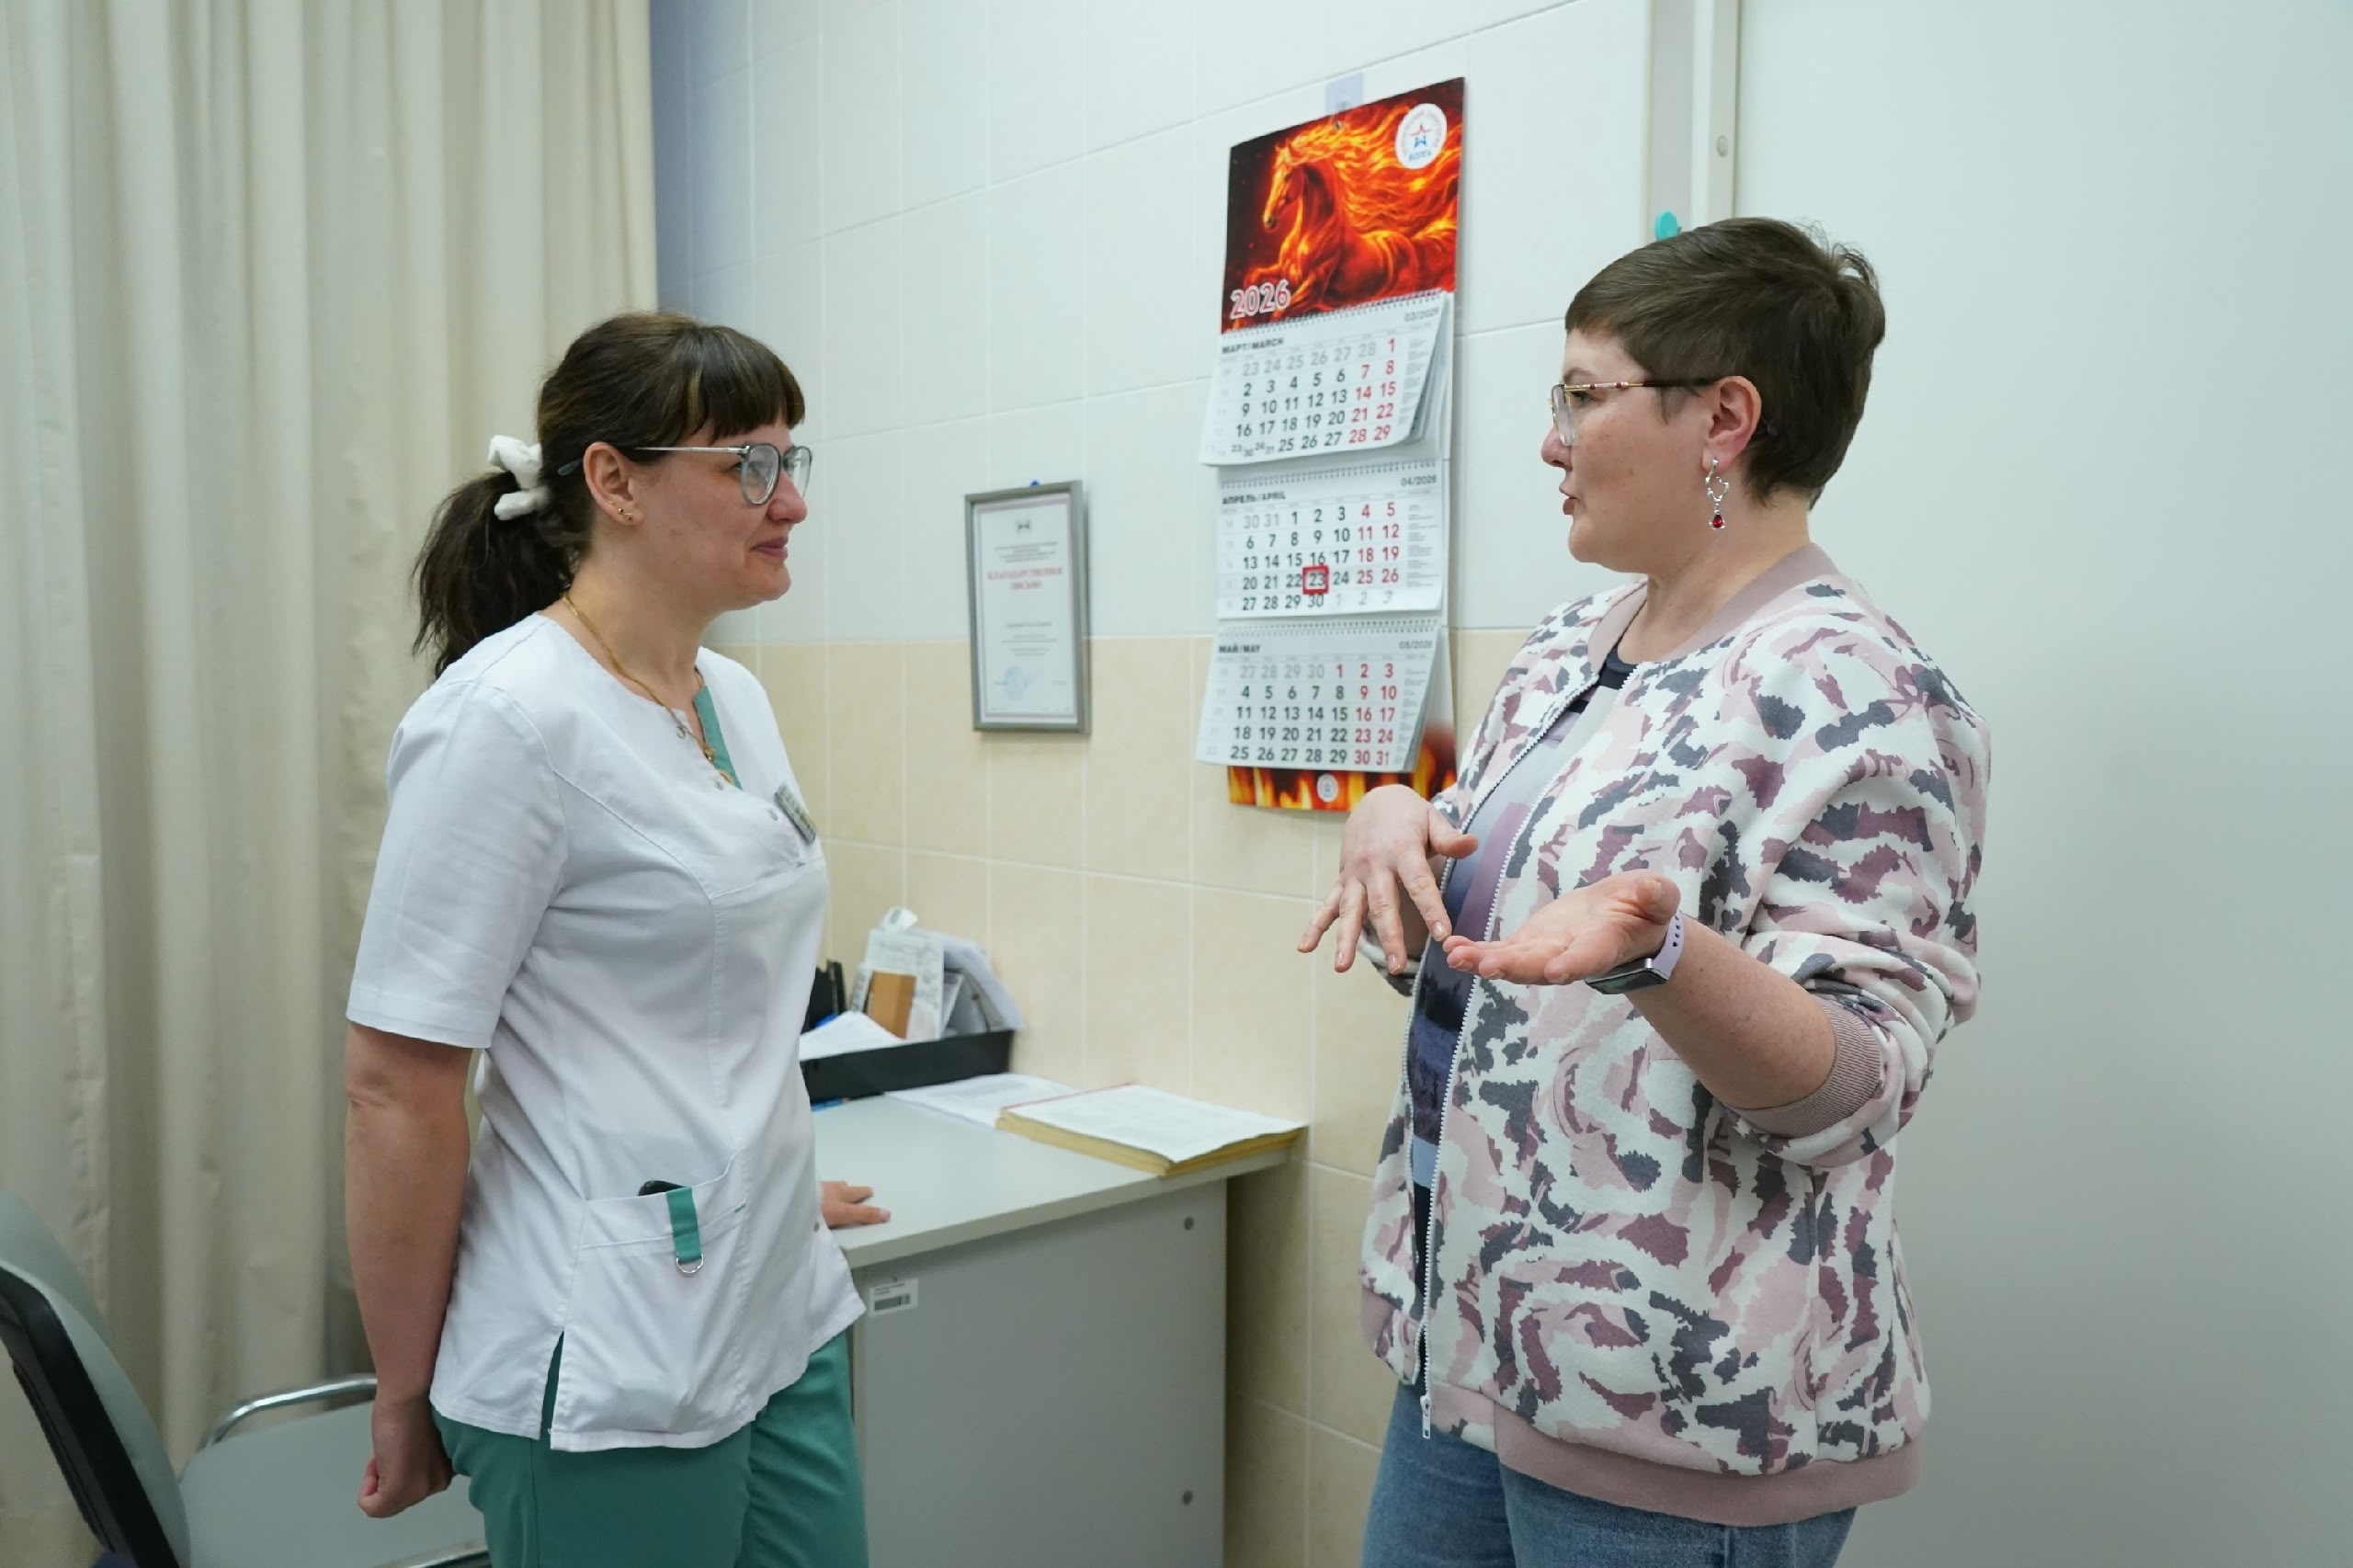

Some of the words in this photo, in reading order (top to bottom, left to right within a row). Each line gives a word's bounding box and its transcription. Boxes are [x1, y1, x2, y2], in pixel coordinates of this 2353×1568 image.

[1229, 279, 1291, 320] 2026
[1243, 361, 1259, 377] 23
[1265, 358, 1280, 374] 24
[1287, 354, 1303, 370] 25
[1311, 350, 1327, 366] 26
[1334, 346, 1351, 362] 27
[1358, 342, 1376, 358] 28
[1389, 338, 1394, 352] 1
[1244, 382, 1252, 397] 2
[1267, 380, 1275, 393] 3
[1290, 376, 1298, 389] 4
[1313, 372, 1321, 387] 5
[1336, 369, 1345, 382] 6
[1362, 364, 1370, 379] 7
[1386, 360, 1394, 375] 8
[1243, 403, 1249, 416] 9
[1262, 400, 1277, 414] 10
[1285, 397, 1298, 411] 11
[1308, 392, 1324, 407] 12
[1332, 389, 1347, 403] 13
[1356, 386, 1371, 401] 14
[1381, 381, 1396, 397] 15
[1236, 424, 1252, 437] 16
[1259, 420, 1275, 435] 17
[1282, 417, 1297, 432] 18
[1306, 414, 1321, 428] 19
[1328, 410, 1345, 425] 20
[1351, 407, 1368, 423] 21
[1377, 403, 1393, 419] 22
[1278, 437, 1294, 452] 25
[1302, 435, 1317, 449] 26
[1324, 431, 1342, 446] 27
[1348, 428, 1367, 444] 28
[1373, 425, 1391, 440] 29
[1244, 515, 1259, 529] 30
[1265, 513, 1279, 528] 31
[1292, 511, 1297, 525] 1
[1314, 509, 1322, 522] 2
[1338, 506, 1345, 520] 3
[1361, 504, 1370, 518] 4
[1387, 502, 1395, 517] 5
[1246, 536, 1254, 550] 6
[1269, 534, 1276, 547] 7
[1291, 531, 1298, 546] 8
[1313, 530, 1322, 543] 9
[1335, 528, 1350, 541] 10
[1358, 526, 1372, 540] 11
[1382, 523, 1399, 539] 12
[1244, 556, 1257, 569] 13
[1265, 554, 1279, 568] 14
[1288, 553, 1302, 566] 15
[1311, 552, 1325, 565] 16
[1334, 550, 1349, 563] 17
[1358, 547, 1373, 562] 18
[1382, 546, 1399, 561] 19
[1243, 576, 1257, 590] 20
[1265, 575, 1278, 589] 21
[1287, 574, 1302, 587] 22
[1309, 572, 1325, 586] 23
[1333, 571, 1349, 585] 24
[1357, 569, 1373, 584] 25
[1382, 568, 1399, 584] 26
[1243, 597, 1256, 610] 27
[1263, 596, 1278, 609] 28
[1285, 595, 1302, 608] 29
[1308, 594, 1324, 607] 30
[1359, 592, 1368, 606] 2
[1240, 665, 1256, 679] 27
[1261, 665, 1278, 679] 28
[1284, 664, 1302, 679] 29
[1308, 664, 1324, 679] 30
[1336, 664, 1343, 678] 1
[1360, 664, 1368, 678] 2
[1385, 664, 1393, 678] 3
[1242, 686, 1249, 699] 4
[1265, 686, 1273, 699] 5
[1288, 686, 1297, 699] 6
[1313, 686, 1320, 699] 7
[1336, 686, 1344, 700] 8
[1360, 686, 1369, 699] 9
[1381, 686, 1397, 700] 10
[1237, 707, 1251, 719] 11
[1261, 706, 1276, 720] 12
[1284, 707, 1300, 721] 13
[1308, 707, 1324, 721] 14
[1332, 707, 1347, 722] 15
[1356, 707, 1371, 722] 16
[1380, 707, 1395, 722] 17
[1234, 726, 1251, 740] 18
[1259, 727, 1276, 740] 19
[1282, 727, 1300, 741] 20
[1307, 728, 1321, 742] 21
[1331, 728, 1347, 743] 22
[1355, 728, 1371, 744] 23
[1378, 728, 1392, 744] 24
[1230, 745, 1249, 760] 25
[1257, 746, 1275, 761] 26
[1281, 748, 1298, 761] 27
[1305, 748, 1322, 763] 28
[1329, 749, 1347, 764] 29
[1354, 749, 1370, 765] 30
[1376, 750, 1389, 766] 31
